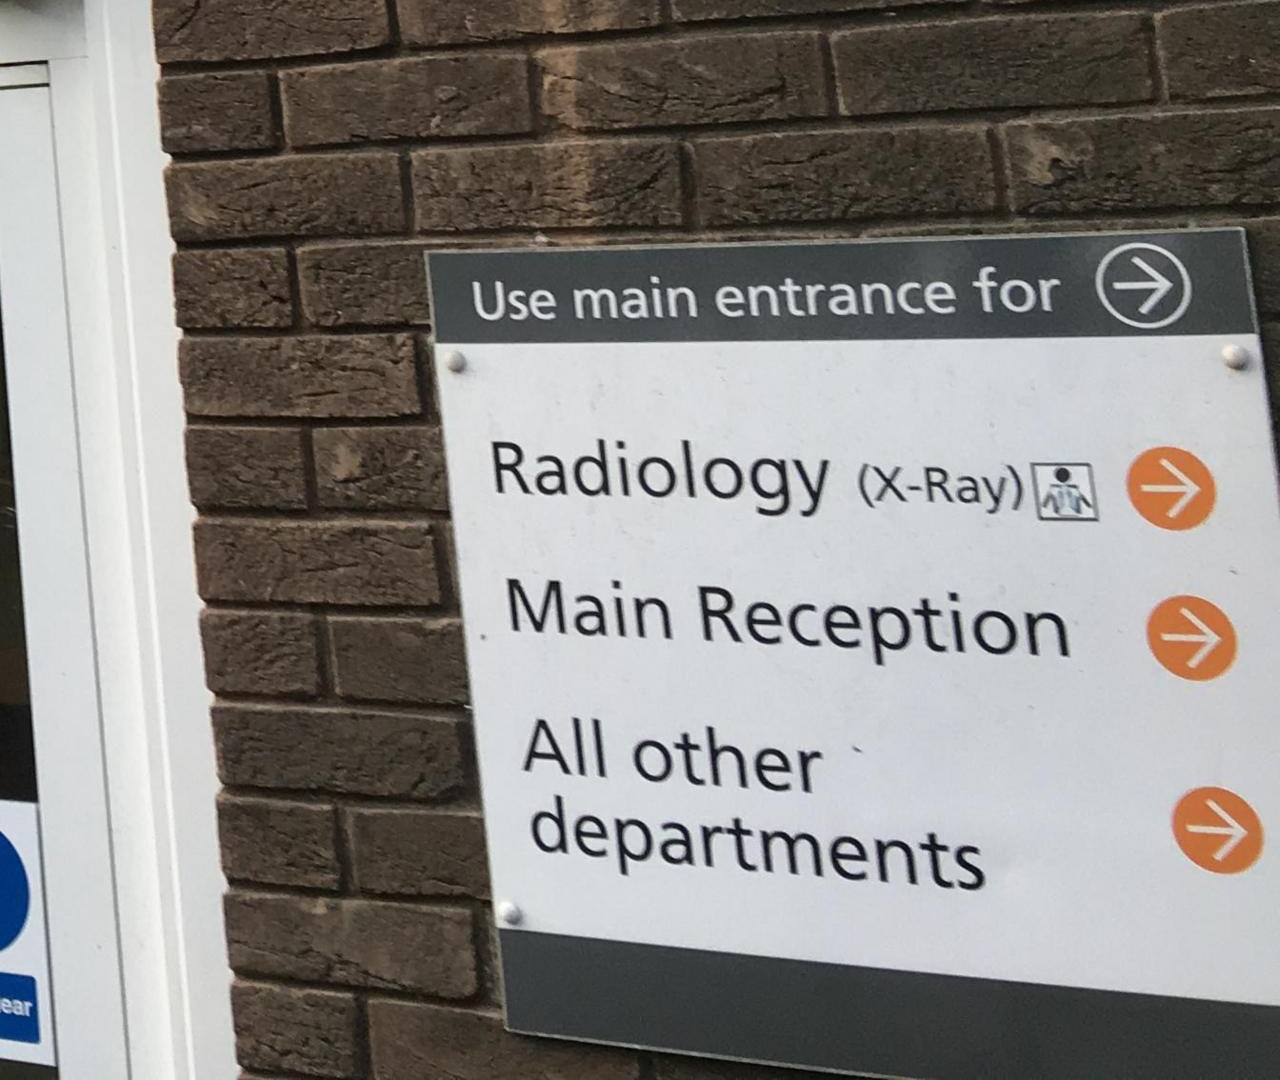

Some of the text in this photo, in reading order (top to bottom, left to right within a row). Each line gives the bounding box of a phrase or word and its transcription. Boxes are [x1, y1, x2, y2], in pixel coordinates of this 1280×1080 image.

[472, 266, 1061, 321] Use main entrance for
[491, 438, 1024, 518] Radiology (X-Ray)
[506, 578, 1070, 666] Main Reception
[523, 717, 823, 793] All other
[531, 794, 987, 891] departments
